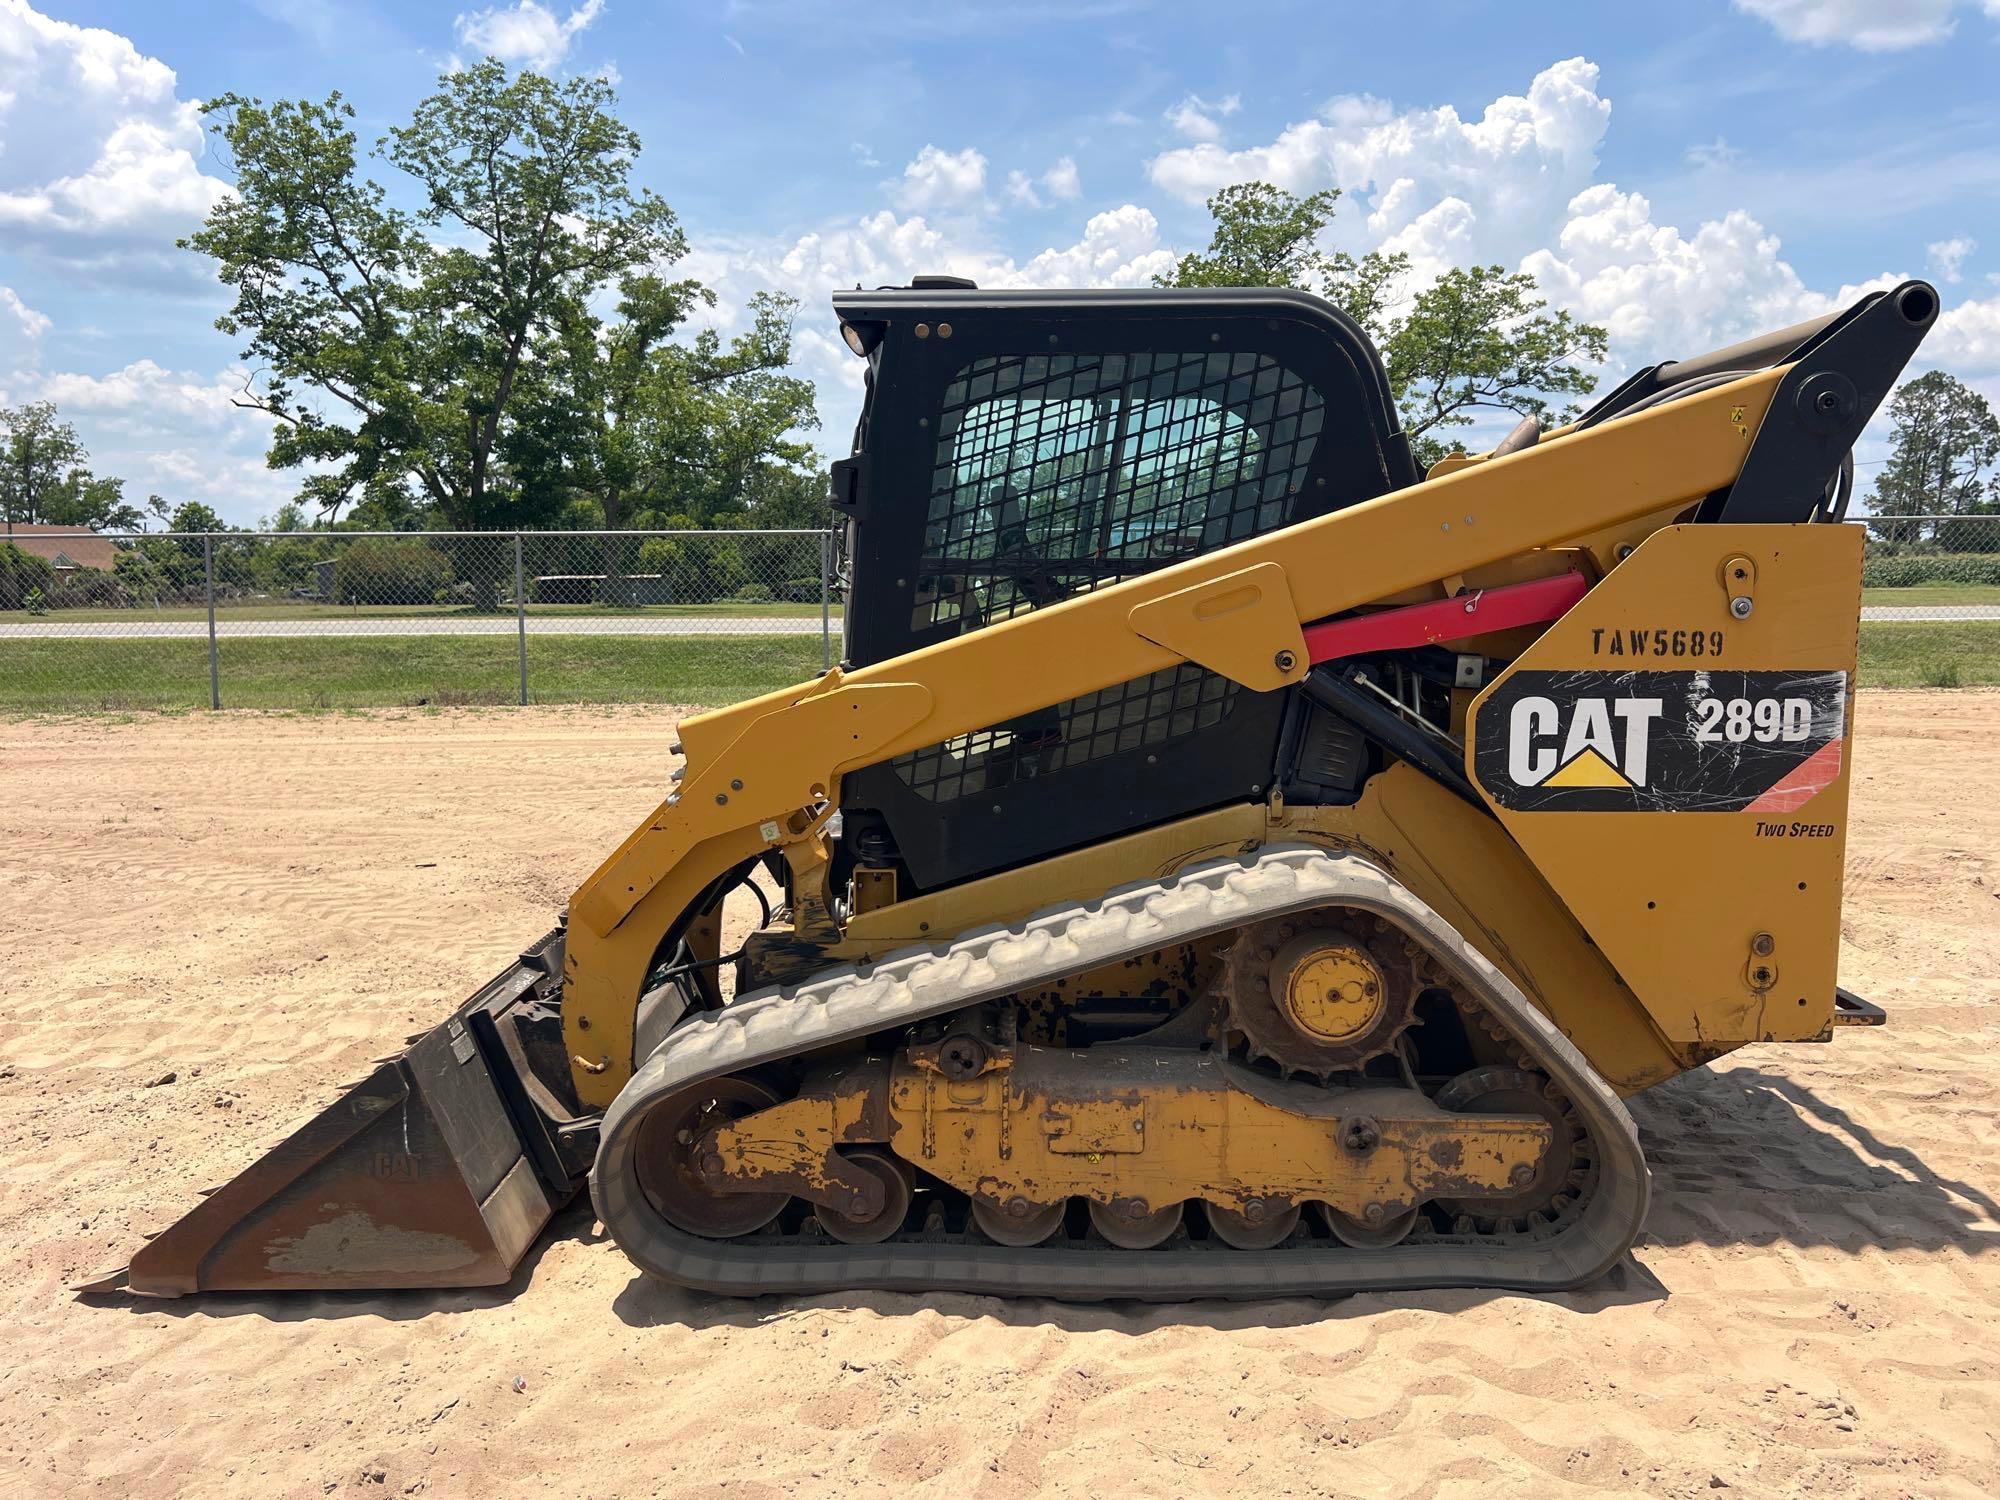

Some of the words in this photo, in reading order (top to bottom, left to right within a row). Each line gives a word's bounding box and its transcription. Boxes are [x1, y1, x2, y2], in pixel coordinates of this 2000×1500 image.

[1591, 628, 1725, 657] TAW5689
[1696, 698, 1812, 743] 289D
[1508, 696, 1663, 787] CAT
[374, 1152, 423, 1182] CAT
